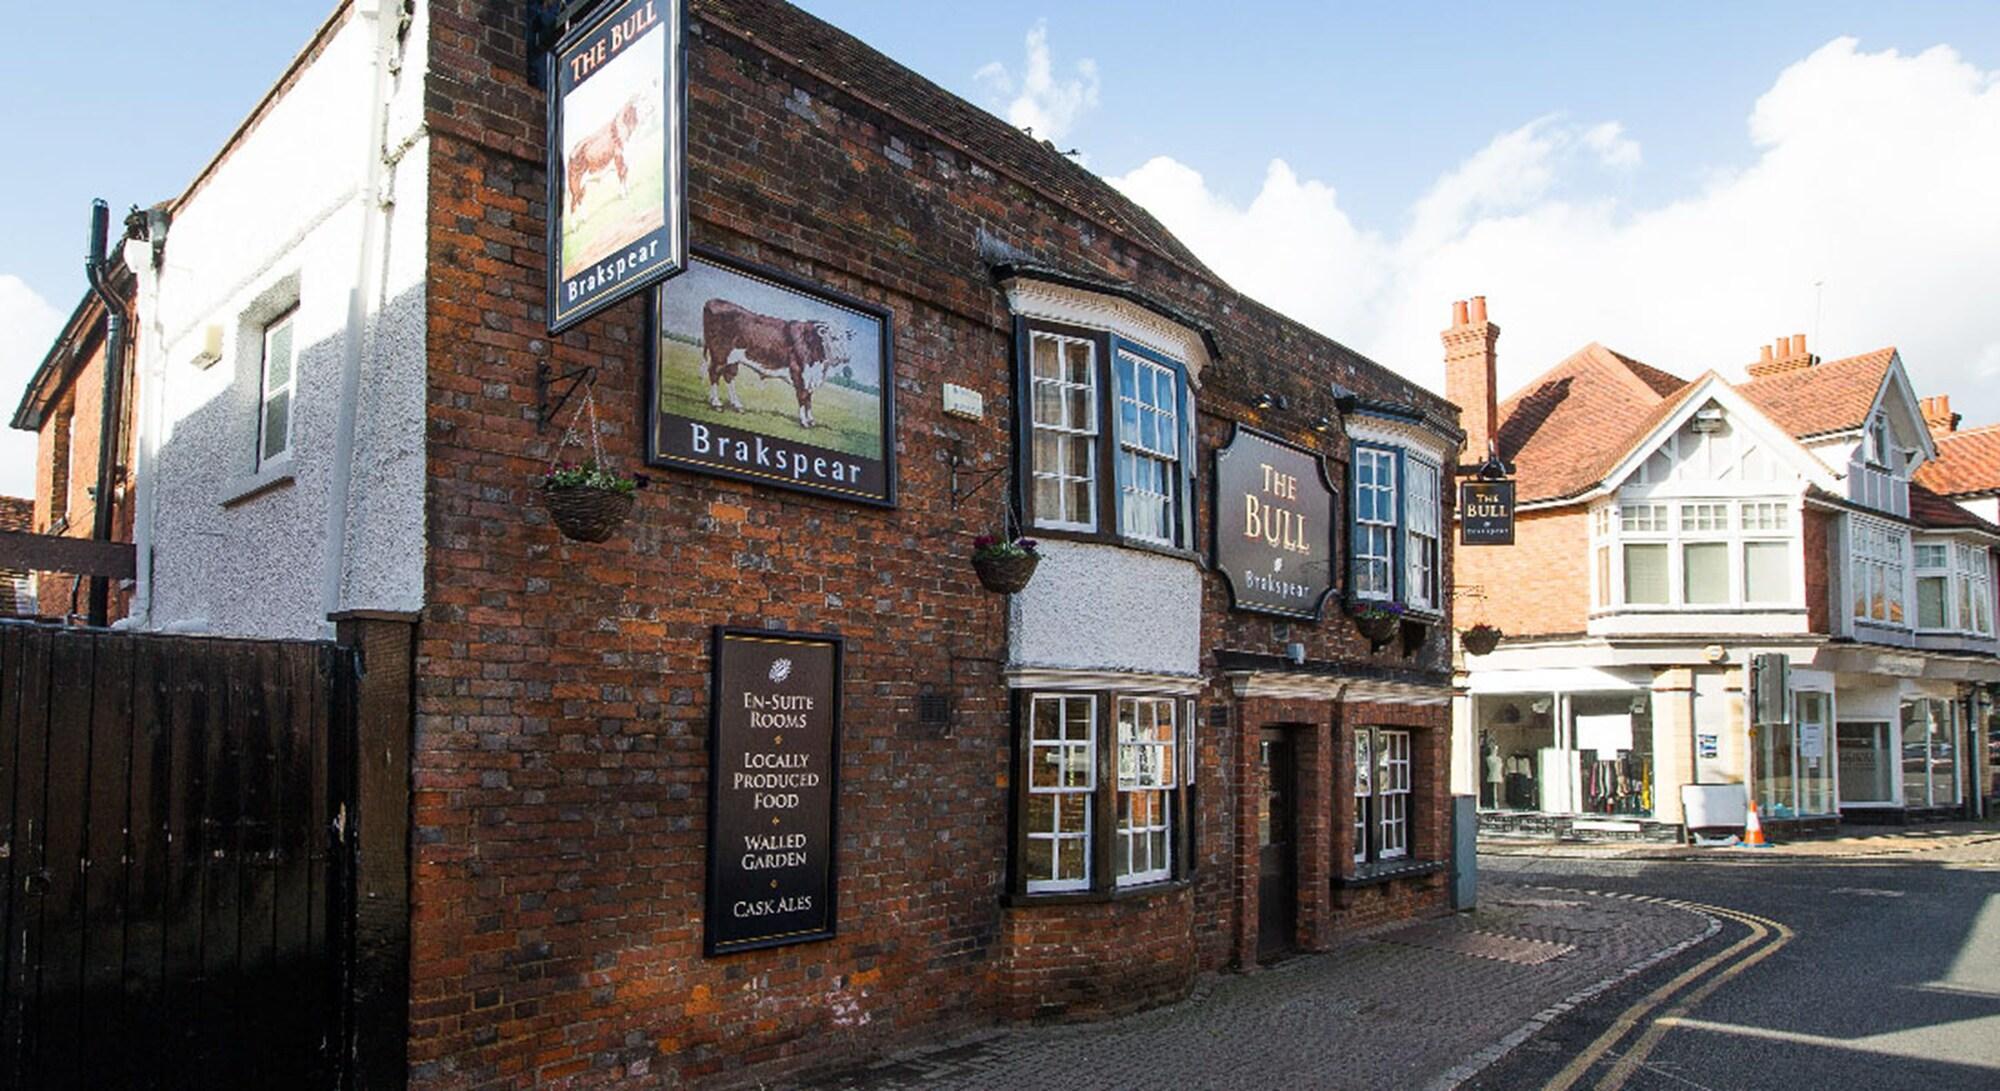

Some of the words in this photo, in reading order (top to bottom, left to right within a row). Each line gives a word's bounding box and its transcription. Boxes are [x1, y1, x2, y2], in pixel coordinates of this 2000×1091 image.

[570, 38, 607, 82] THE
[610, 1, 657, 52] BULL
[568, 240, 658, 302] Brakspear
[690, 422, 861, 484] Brakspear
[1260, 463, 1297, 500] THE
[1476, 493, 1499, 503] THE
[1466, 503, 1508, 518] BULL
[1243, 492, 1311, 555] BULL
[1245, 570, 1311, 599] Brakspear
[744, 692, 814, 711] EN-SUITE
[750, 712, 807, 729] ROOMS
[744, 752, 810, 769] LOCALLY
[733, 772, 820, 790] PRODUCED
[754, 793, 800, 810] FOOD
[744, 833, 807, 851] WALLED
[741, 852, 807, 870] GARDEN
[733, 900, 775, 918] CASK
[776, 896, 812, 913] ALES
